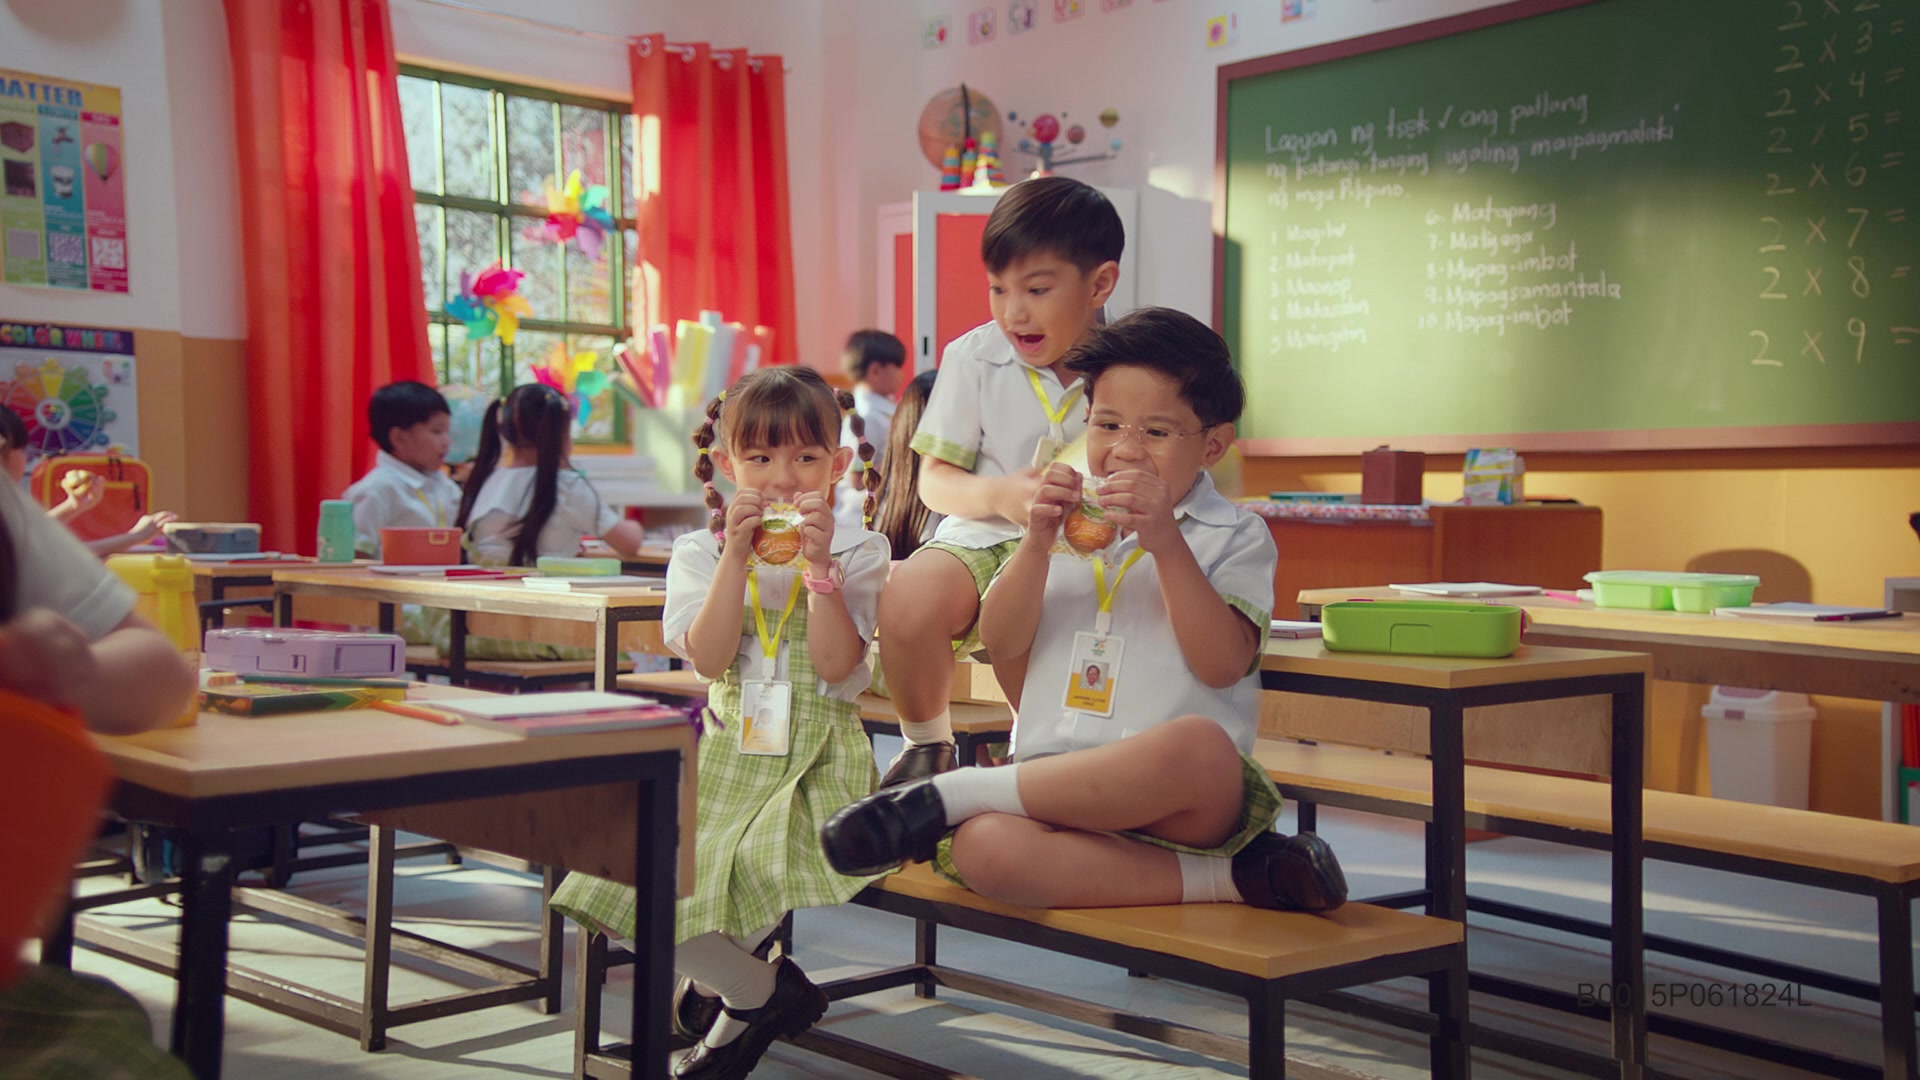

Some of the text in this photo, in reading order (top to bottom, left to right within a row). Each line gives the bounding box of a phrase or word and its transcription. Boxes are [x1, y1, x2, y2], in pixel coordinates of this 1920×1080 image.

[1774, 44, 1804, 72] 2
[1855, 20, 1872, 54] 3
[1766, 88, 1797, 117] 2
[1849, 71, 1866, 98] 4
[1351, 121, 1375, 157] ng
[1459, 109, 1498, 136] ang
[1767, 126, 1793, 153] 2
[1849, 113, 1870, 142] 5
[1766, 172, 1796, 196] 2
[1845, 152, 1867, 186] 6
[1760, 216, 1787, 253] 2
[1847, 207, 1869, 248] 7
[1760, 266, 1788, 299] 2
[1849, 255, 1870, 299] 8
[0, 324, 64, 347] COLOR
[1749, 329, 1784, 367] 2
[1847, 316, 1866, 365] 9
